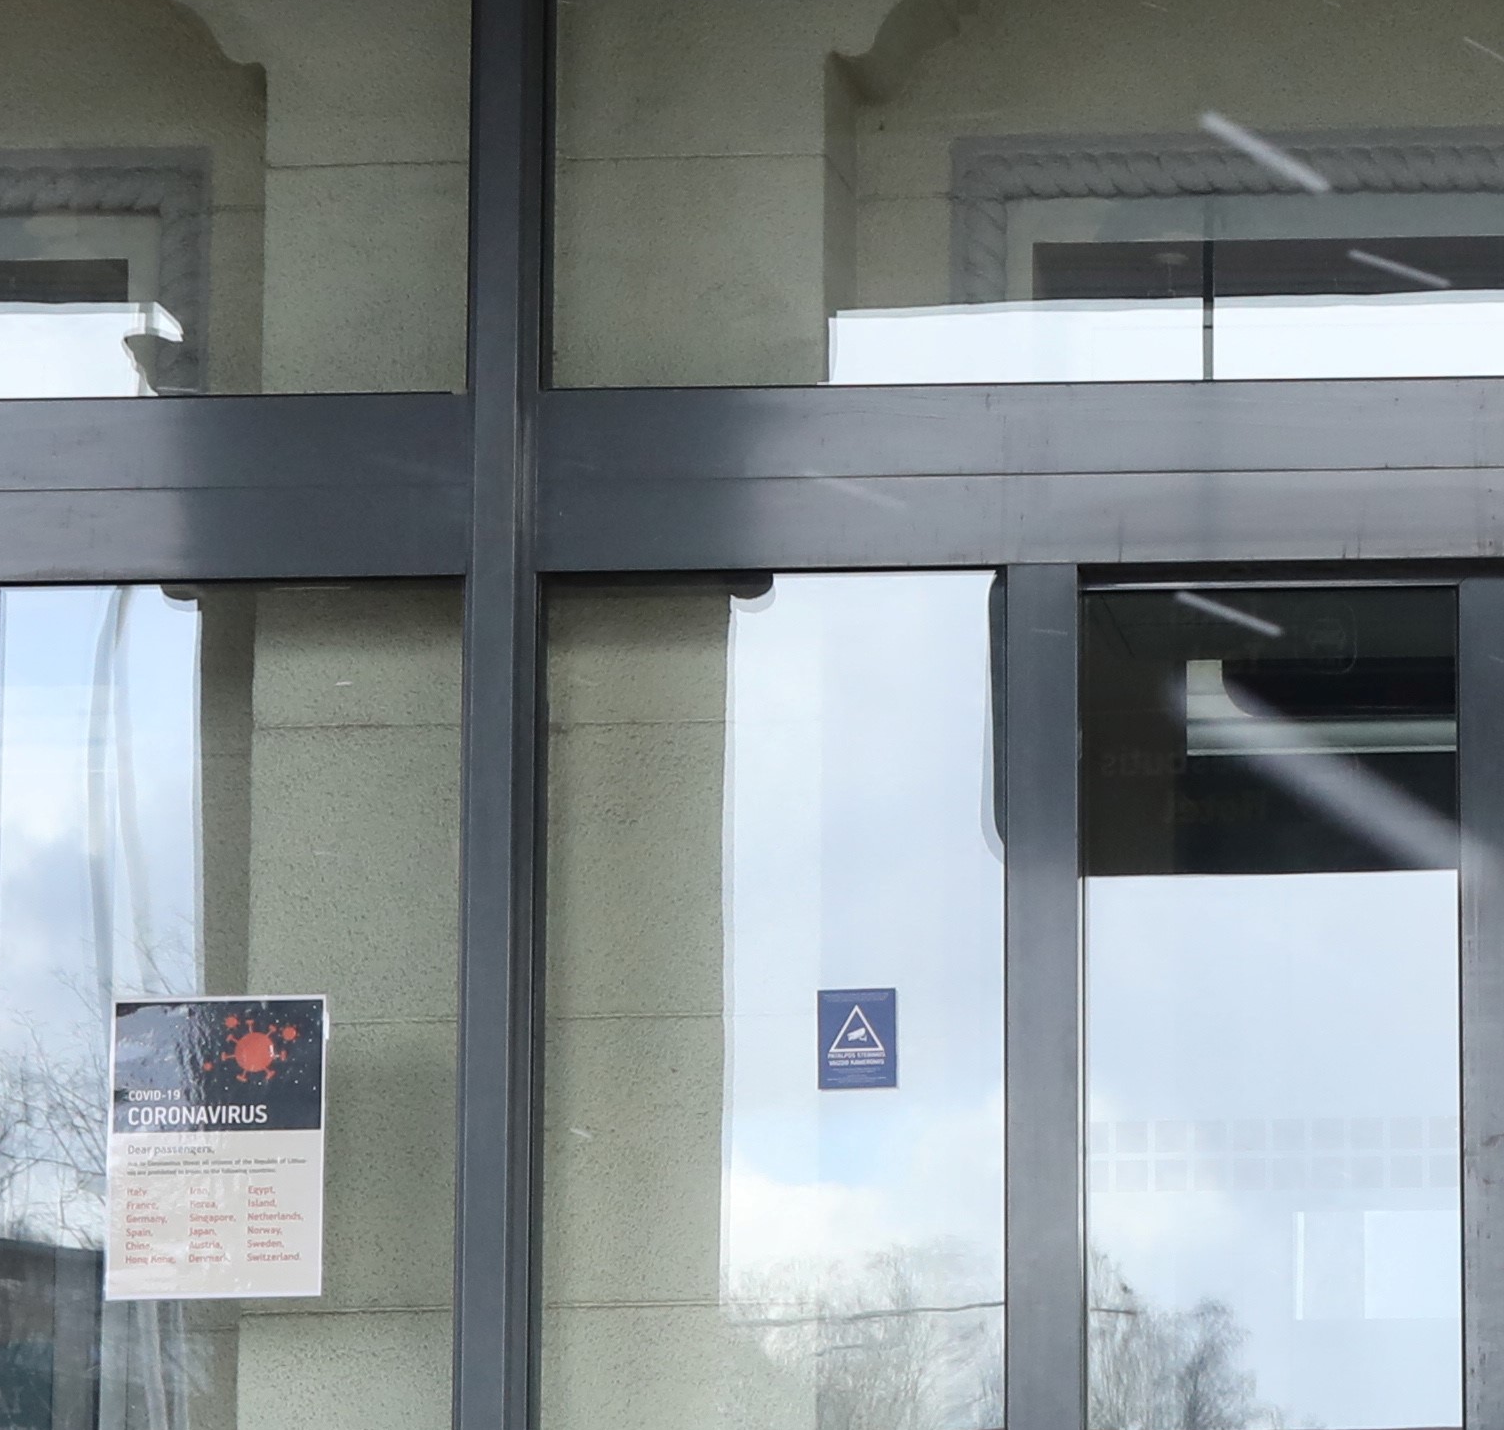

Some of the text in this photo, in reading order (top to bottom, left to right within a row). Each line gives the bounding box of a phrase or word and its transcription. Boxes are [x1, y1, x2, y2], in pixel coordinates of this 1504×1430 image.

[129, 1090, 181, 1101] COVID-19
[128, 1105, 267, 1125] CORONAVIRUS
[127, 1145, 151, 1155] Dear
